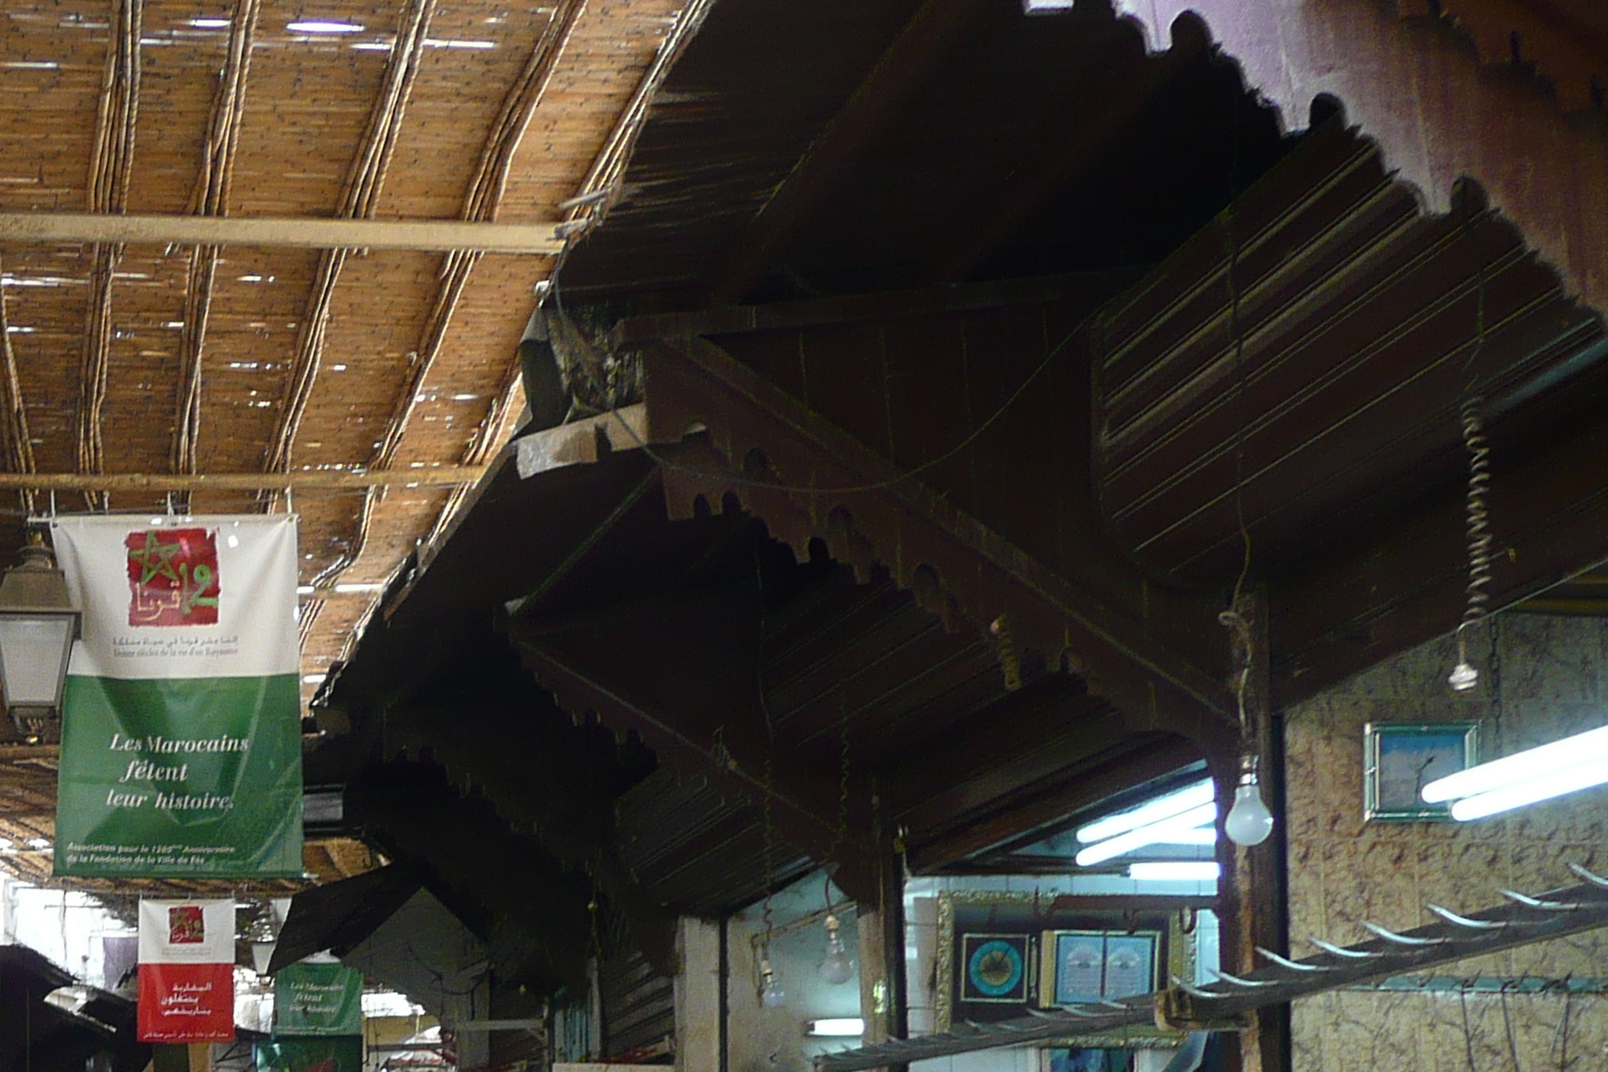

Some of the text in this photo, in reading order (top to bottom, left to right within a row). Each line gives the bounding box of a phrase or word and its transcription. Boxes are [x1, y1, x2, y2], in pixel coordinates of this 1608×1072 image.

[110, 733, 250, 753] Les Marocains
[118, 759, 189, 784] fêtent
[106, 789, 235, 810] leur histoire.
